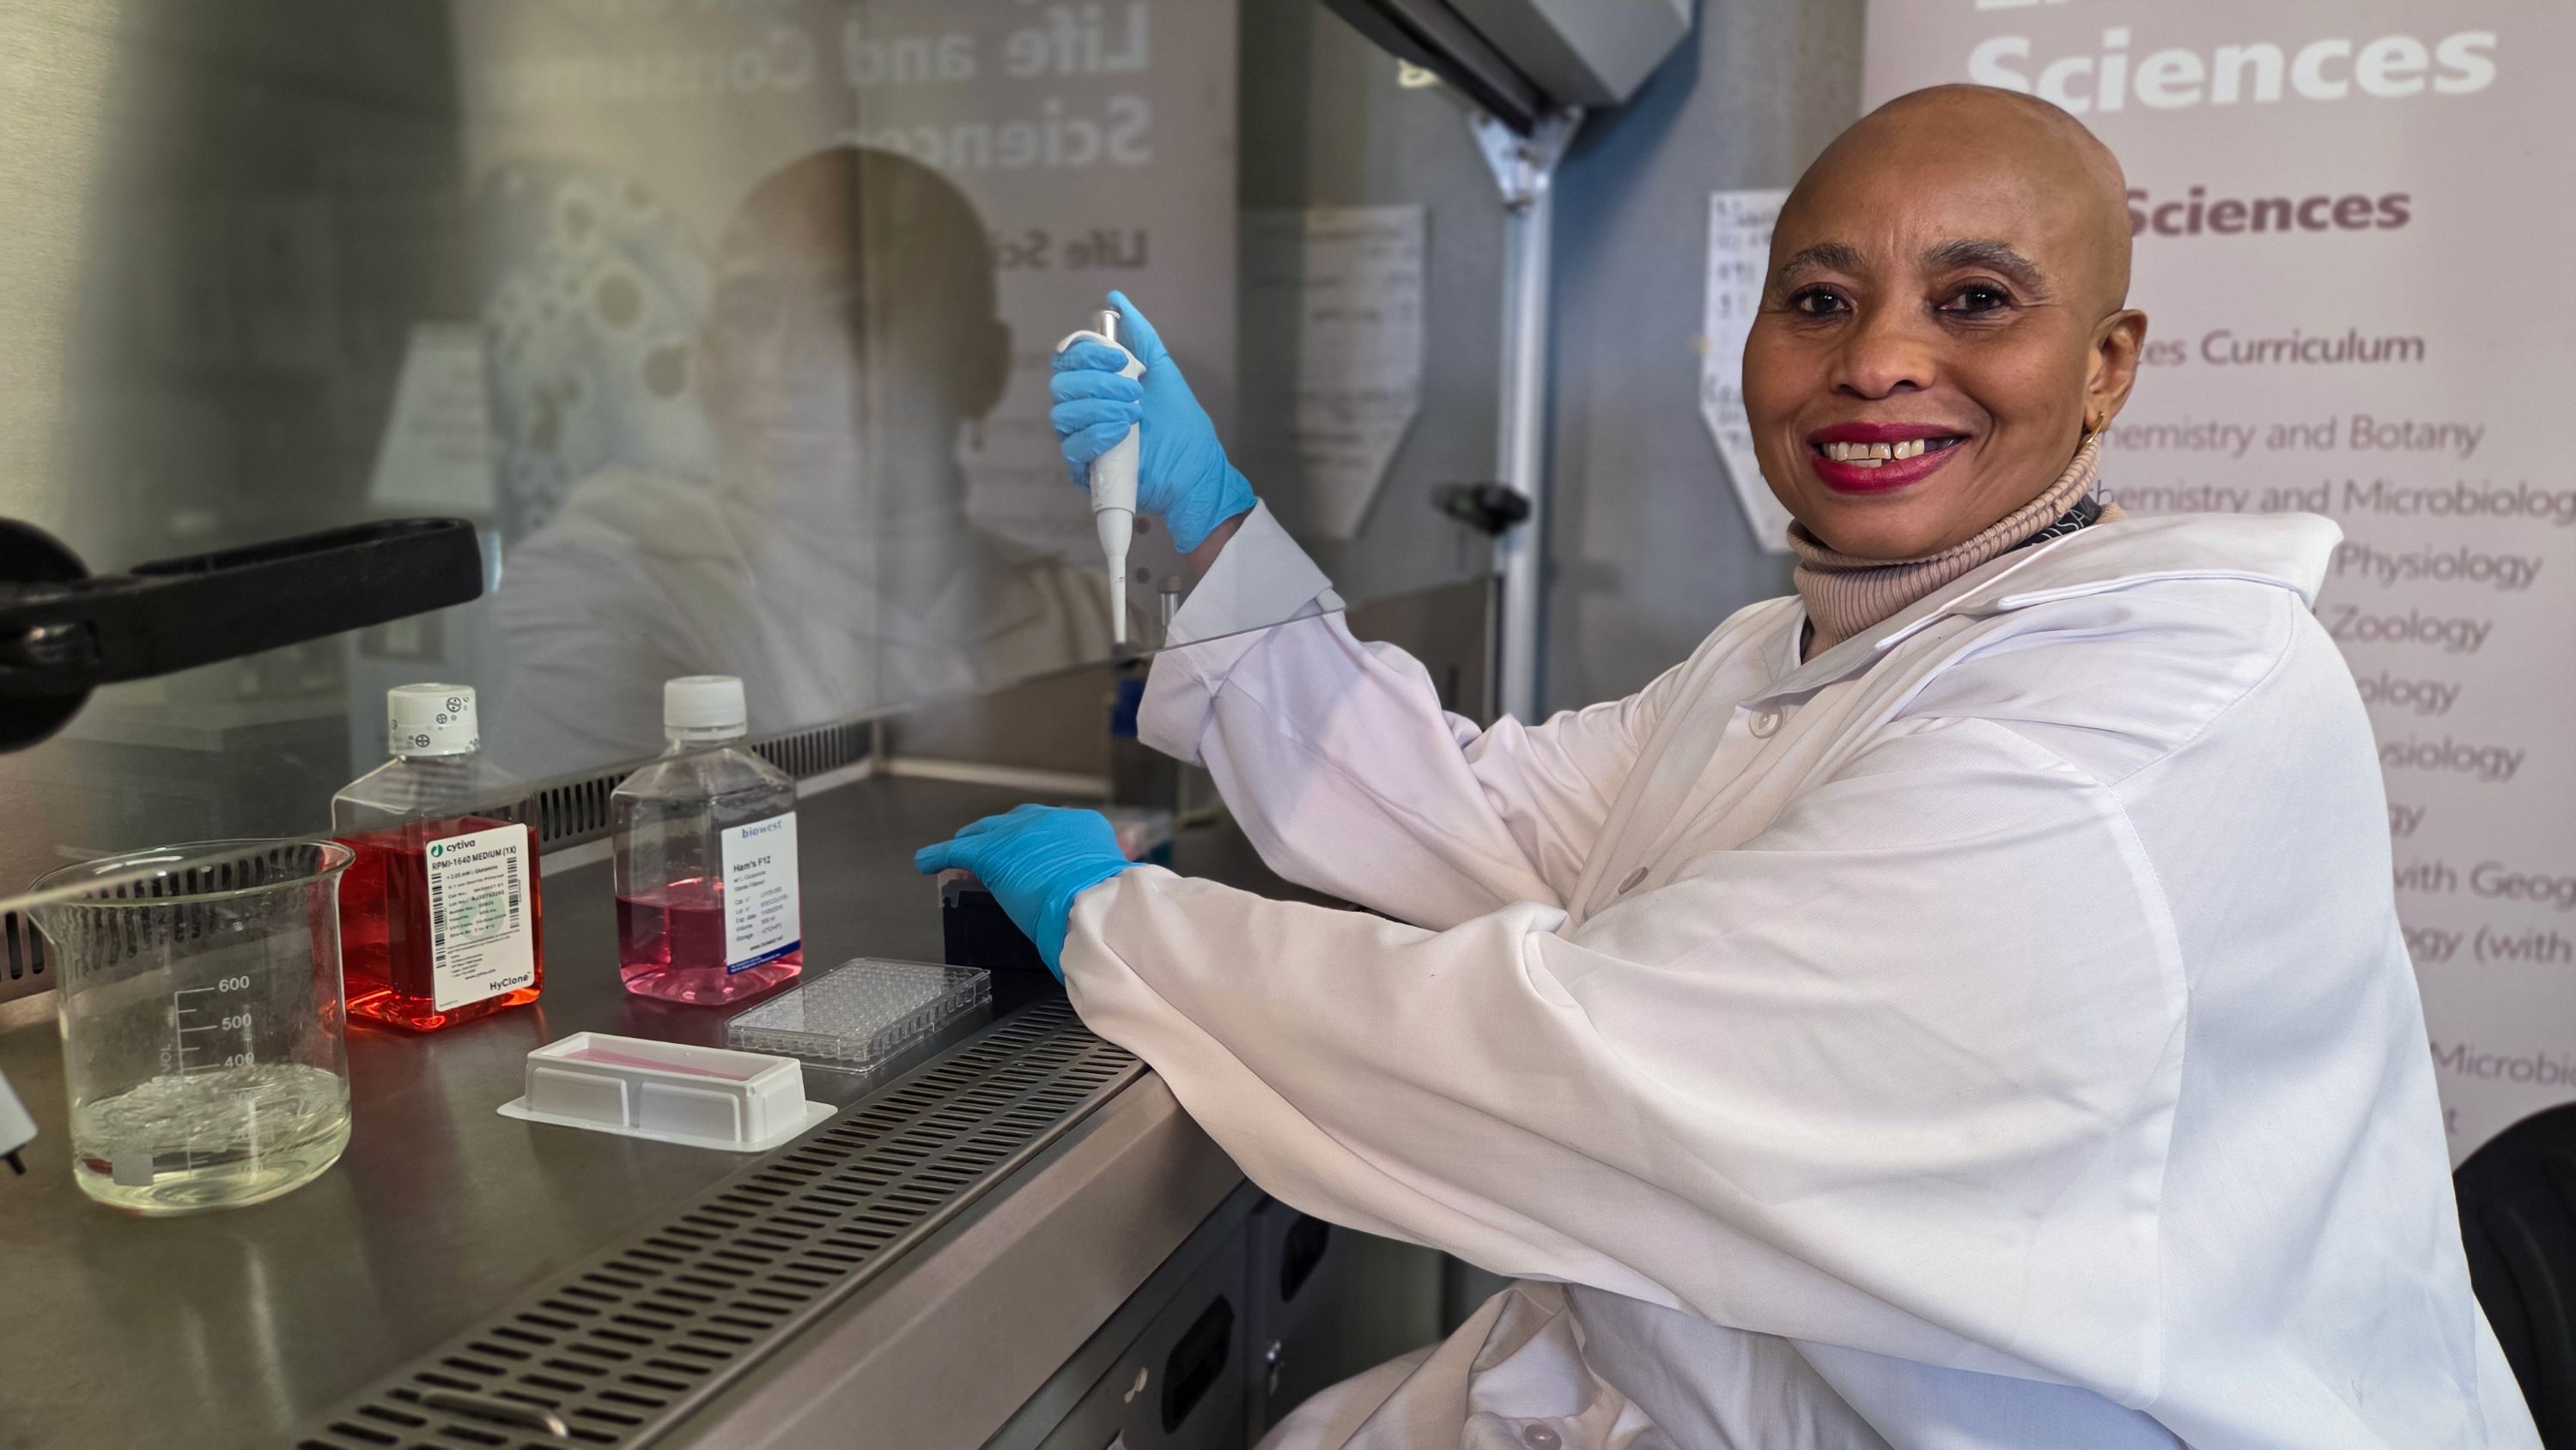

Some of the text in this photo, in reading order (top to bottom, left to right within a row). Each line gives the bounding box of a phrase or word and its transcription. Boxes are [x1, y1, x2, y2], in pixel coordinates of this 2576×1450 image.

[1968, 27, 2498, 115] Sciences
[2137, 328, 2425, 367] es Curriculum
[2266, 416, 2337, 452] and
[2348, 414, 2484, 458] Botany
[2260, 479, 2332, 513] and
[2334, 541, 2543, 590] Physiology
[2329, 604, 2493, 656] Zoology
[742, 820, 782, 838] biowest
[432, 846, 517, 871] RPMI-1640 MEDIUM (1X)
[447, 840, 476, 852] cytiva
[733, 855, 772, 872] Ham's F12
[2473, 922, 2573, 967] (with
[218, 975, 251, 992] 600
[489, 974, 529, 991] HyClone
[222, 1013, 252, 1031] 500
[224, 1052, 255, 1068] 400
